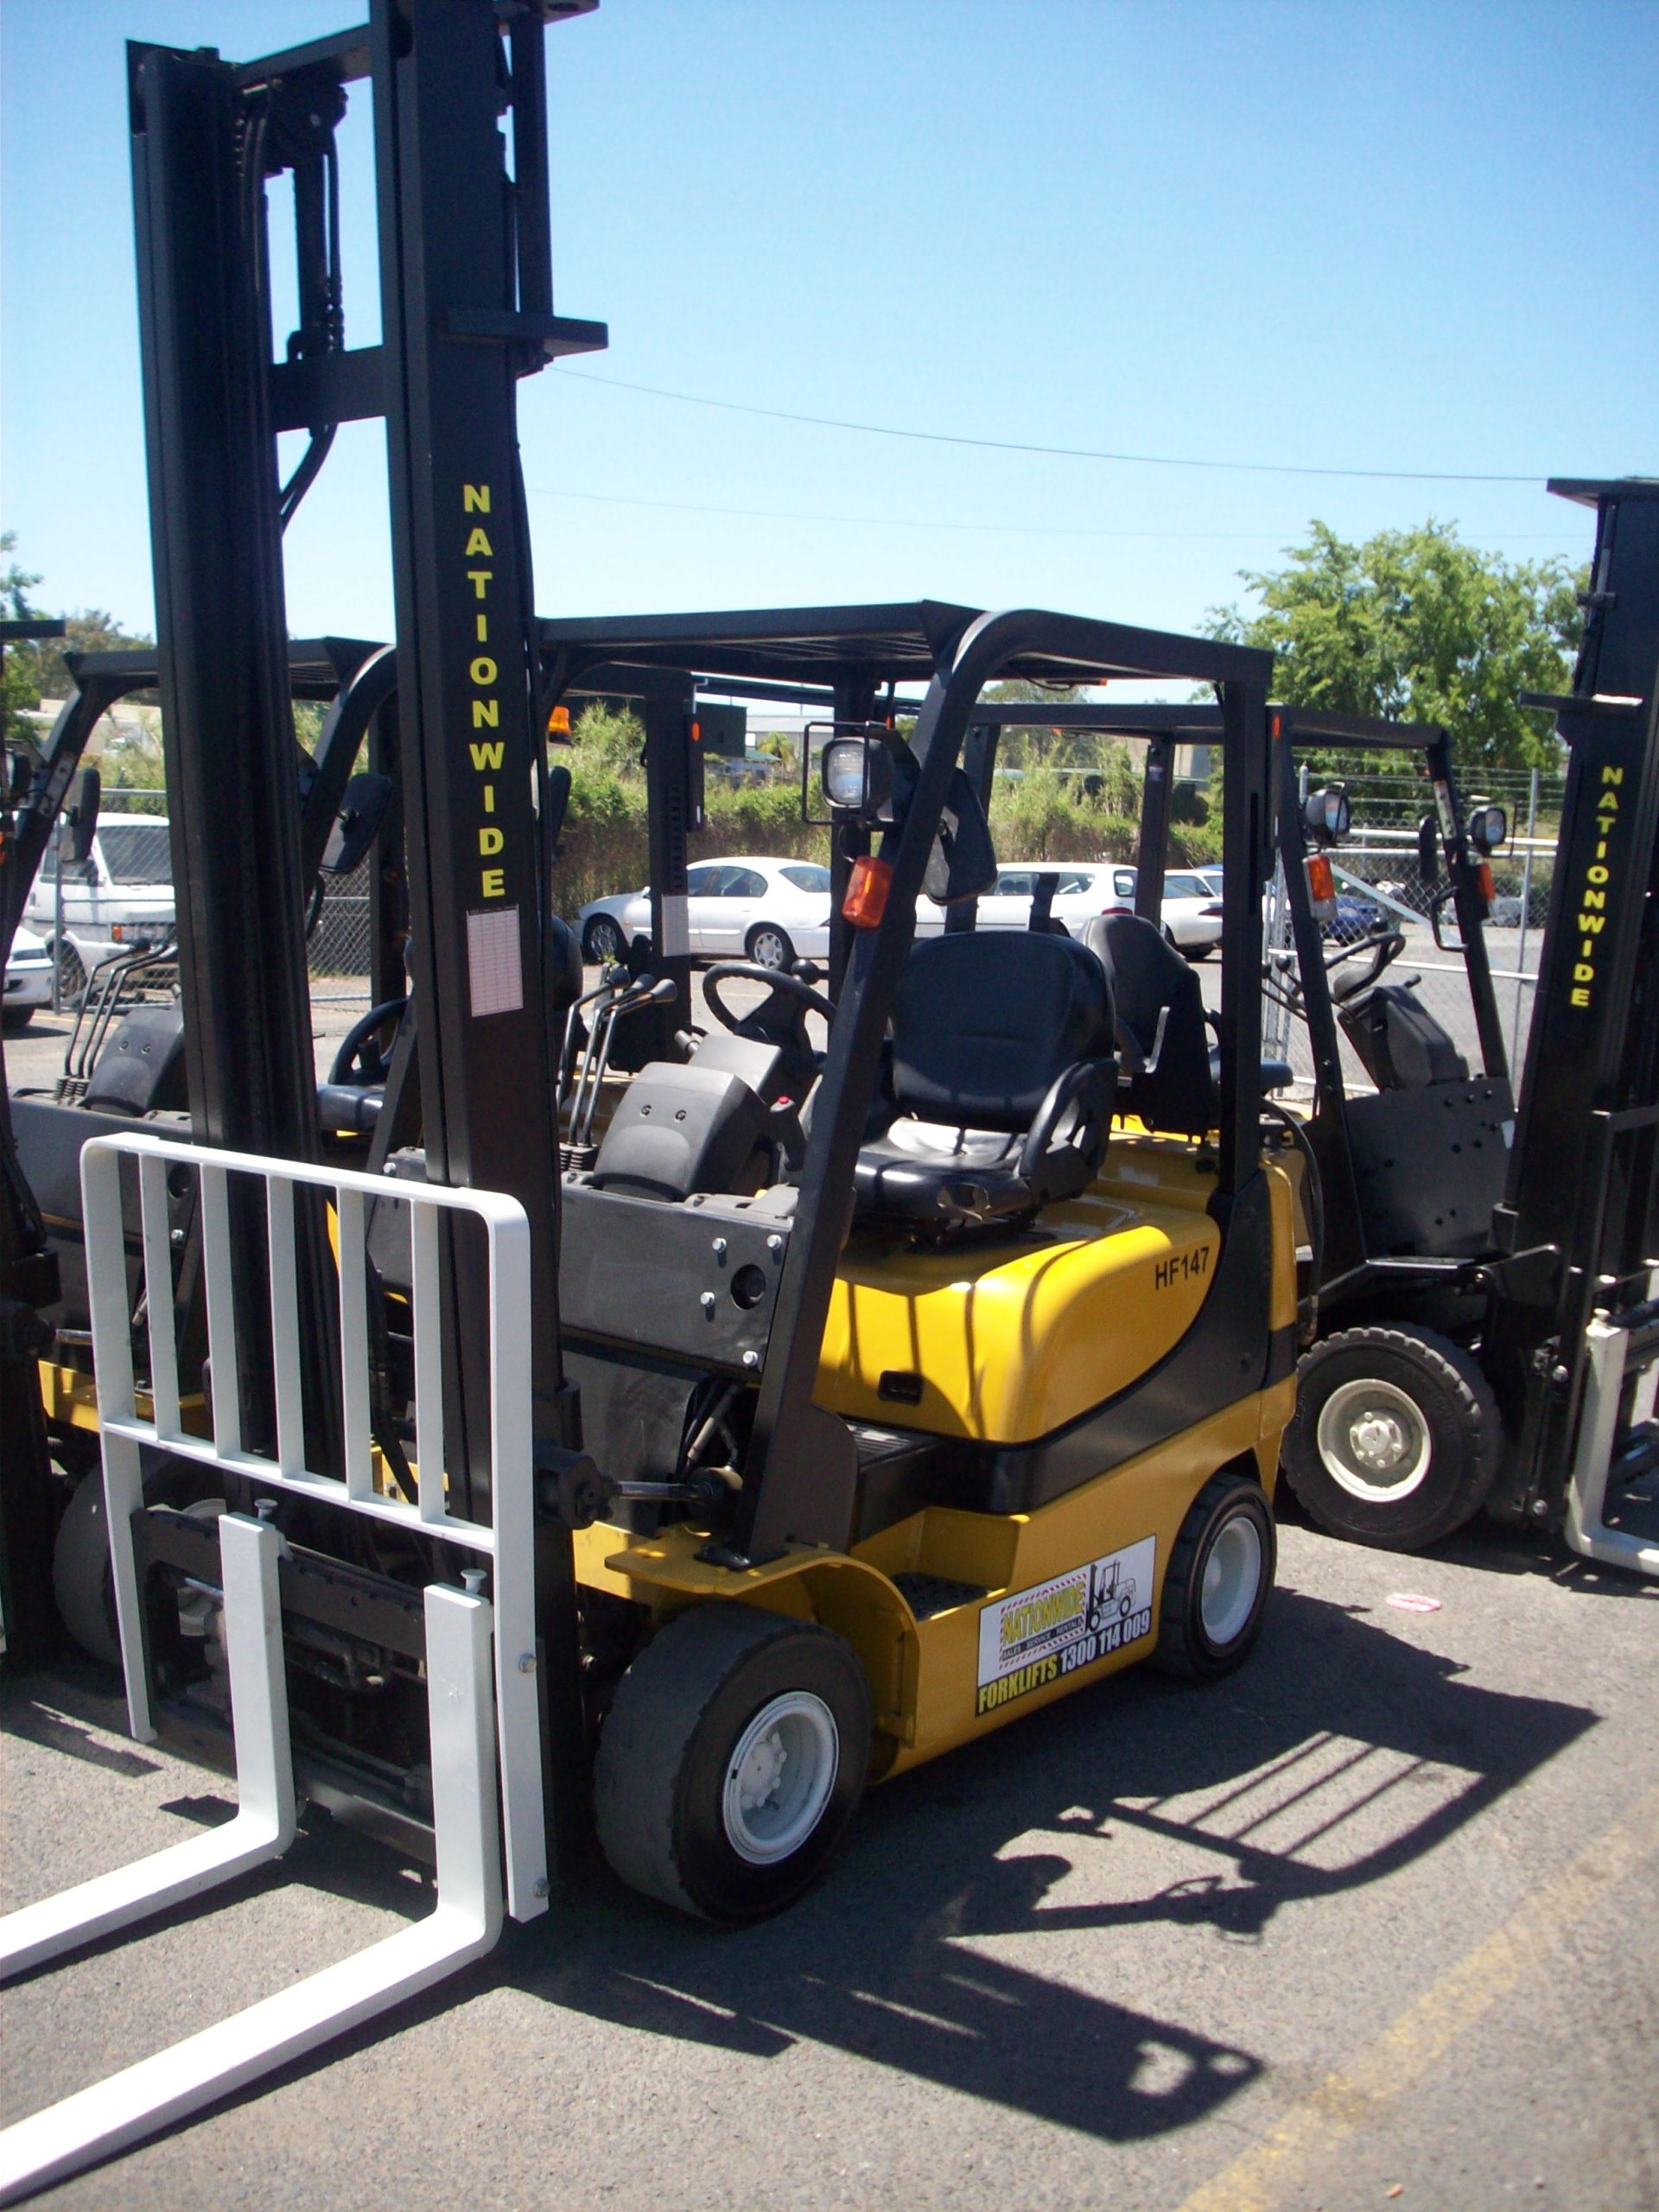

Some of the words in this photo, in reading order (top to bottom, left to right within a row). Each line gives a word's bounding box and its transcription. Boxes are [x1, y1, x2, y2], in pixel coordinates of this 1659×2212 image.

[462, 484, 505, 899] NATIONWIDE
[1570, 766, 1624, 1007] NATIONWIDE
[1154, 1246, 1210, 1291] HF147
[978, 1653, 1058, 1714] FORKLIFTS
[1059, 1633, 1096, 1675] 1300
[1098, 1625, 1121, 1655] 114
[1123, 1610, 1150, 1643] 009
[1002, 1581, 1085, 1647] NATIONWIDE
